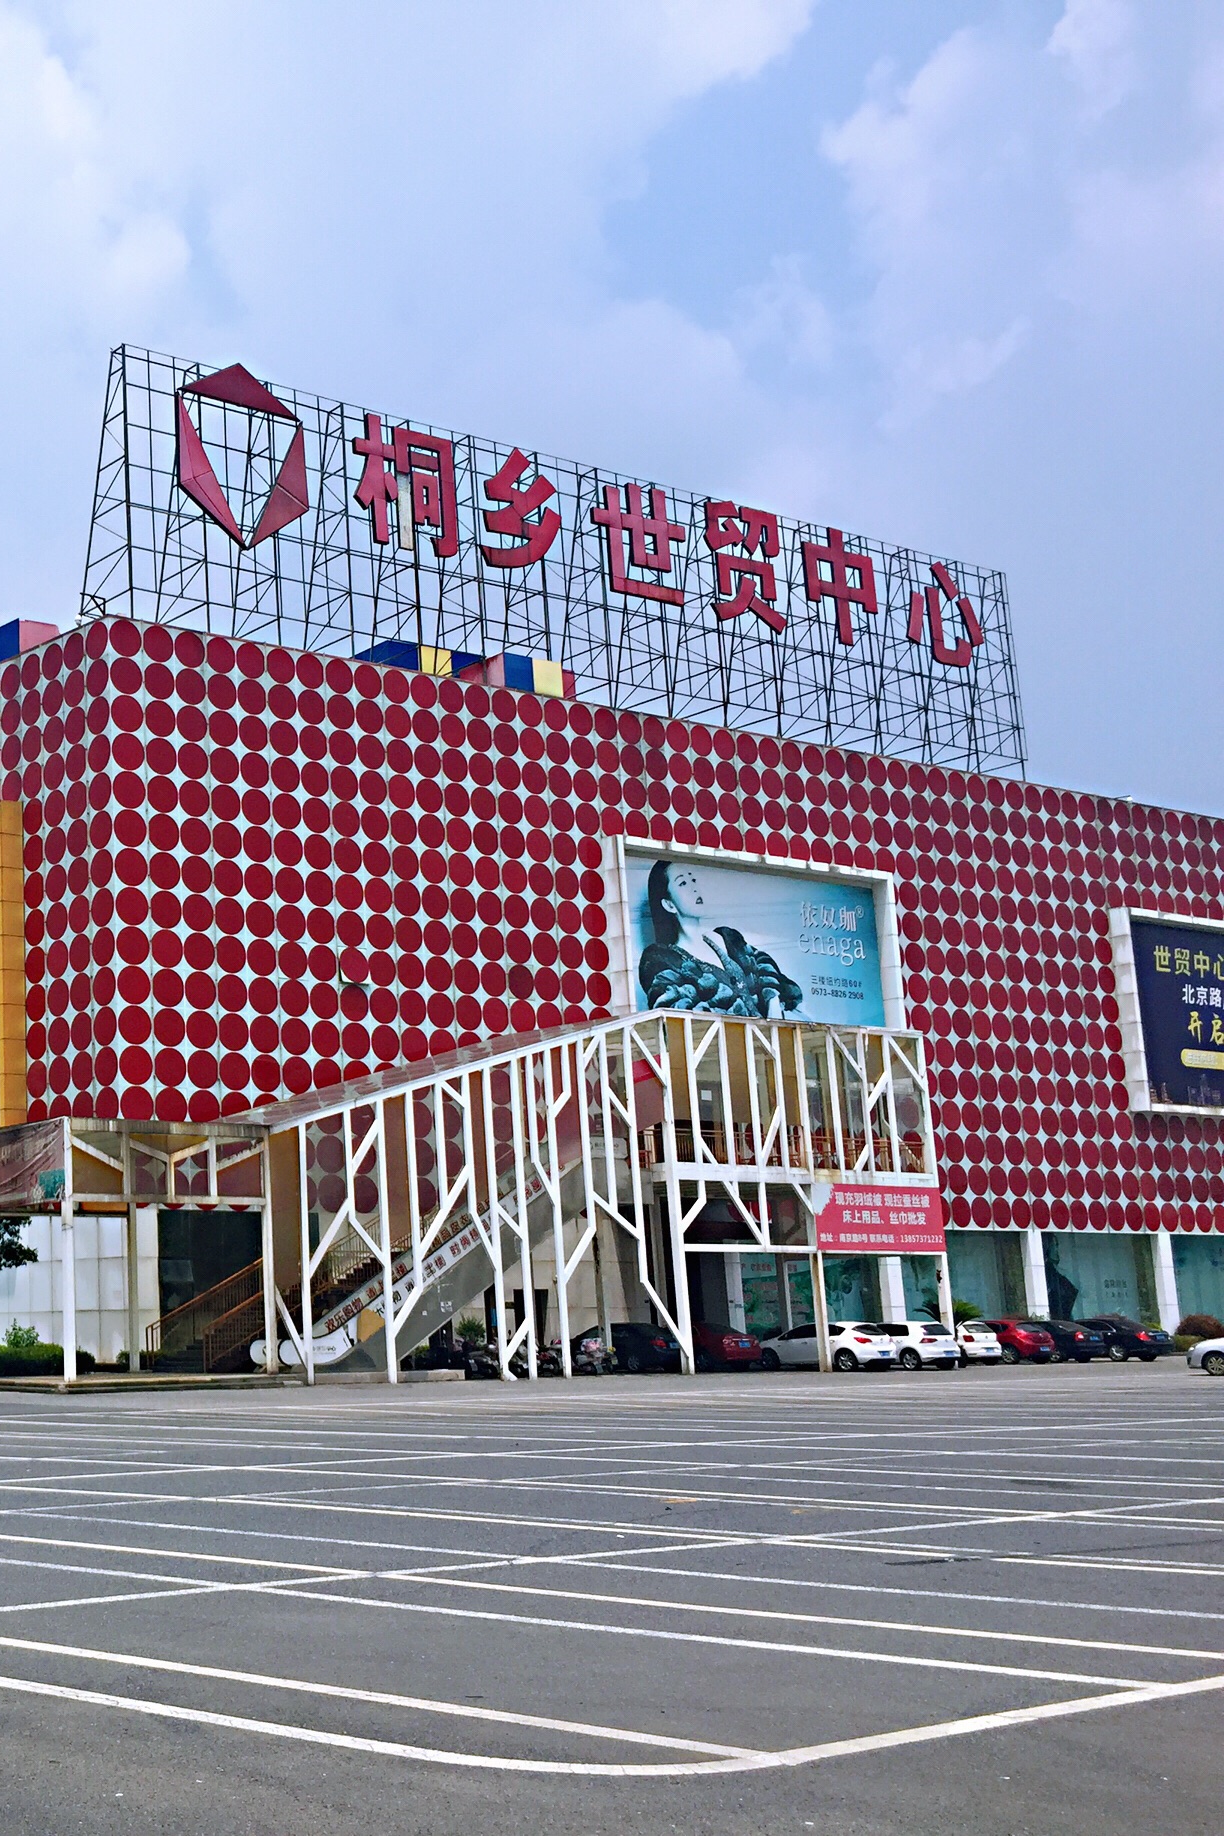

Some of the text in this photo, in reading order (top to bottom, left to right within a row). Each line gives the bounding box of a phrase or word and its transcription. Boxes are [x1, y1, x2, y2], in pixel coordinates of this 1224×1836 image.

[353, 412, 984, 669] 桐乡世贸中心
[799, 934, 866, 967] enaga
[1153, 945, 1224, 981] 世贸中心
[1182, 983, 1224, 1009] 北京路
